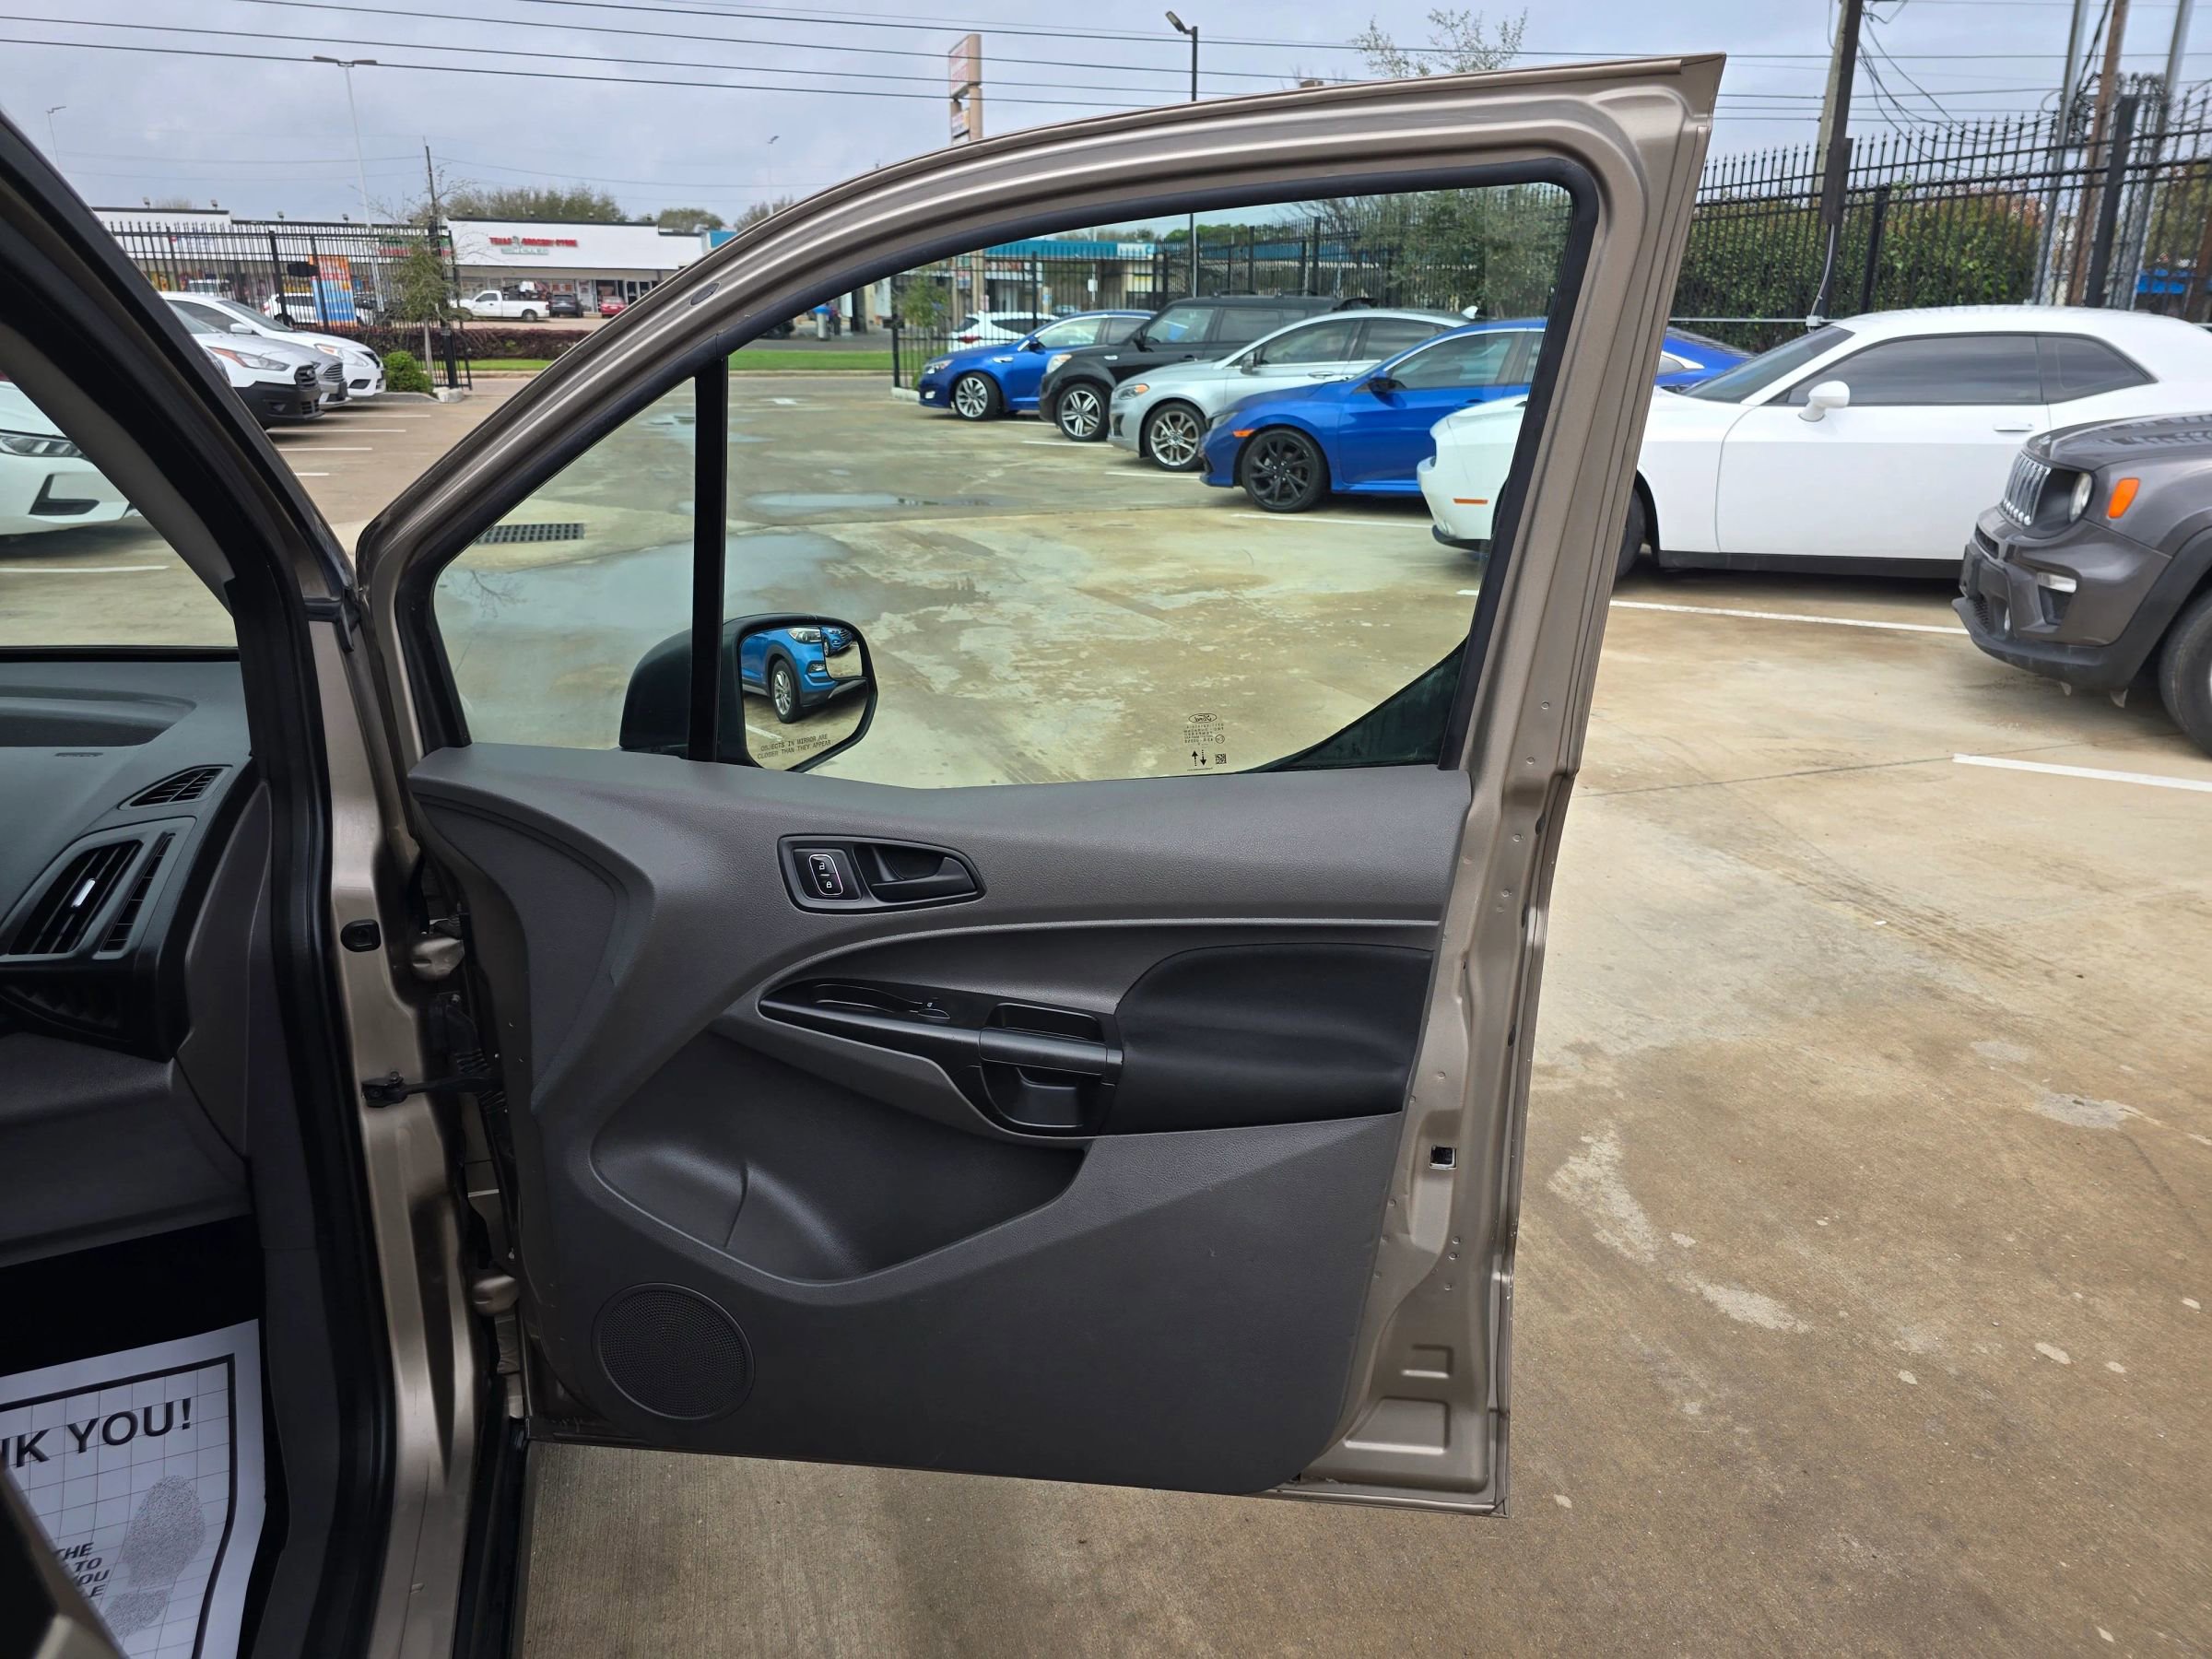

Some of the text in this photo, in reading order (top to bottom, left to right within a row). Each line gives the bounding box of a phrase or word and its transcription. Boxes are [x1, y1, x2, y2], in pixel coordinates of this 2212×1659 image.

[760, 742, 785, 750] OBJECTS
[797, 735, 817, 744] MIRROR
[758, 751, 779, 759] CLOSER
[67, 1397, 190, 1453] YOU!
[75, 1558, 102, 1572] TO
